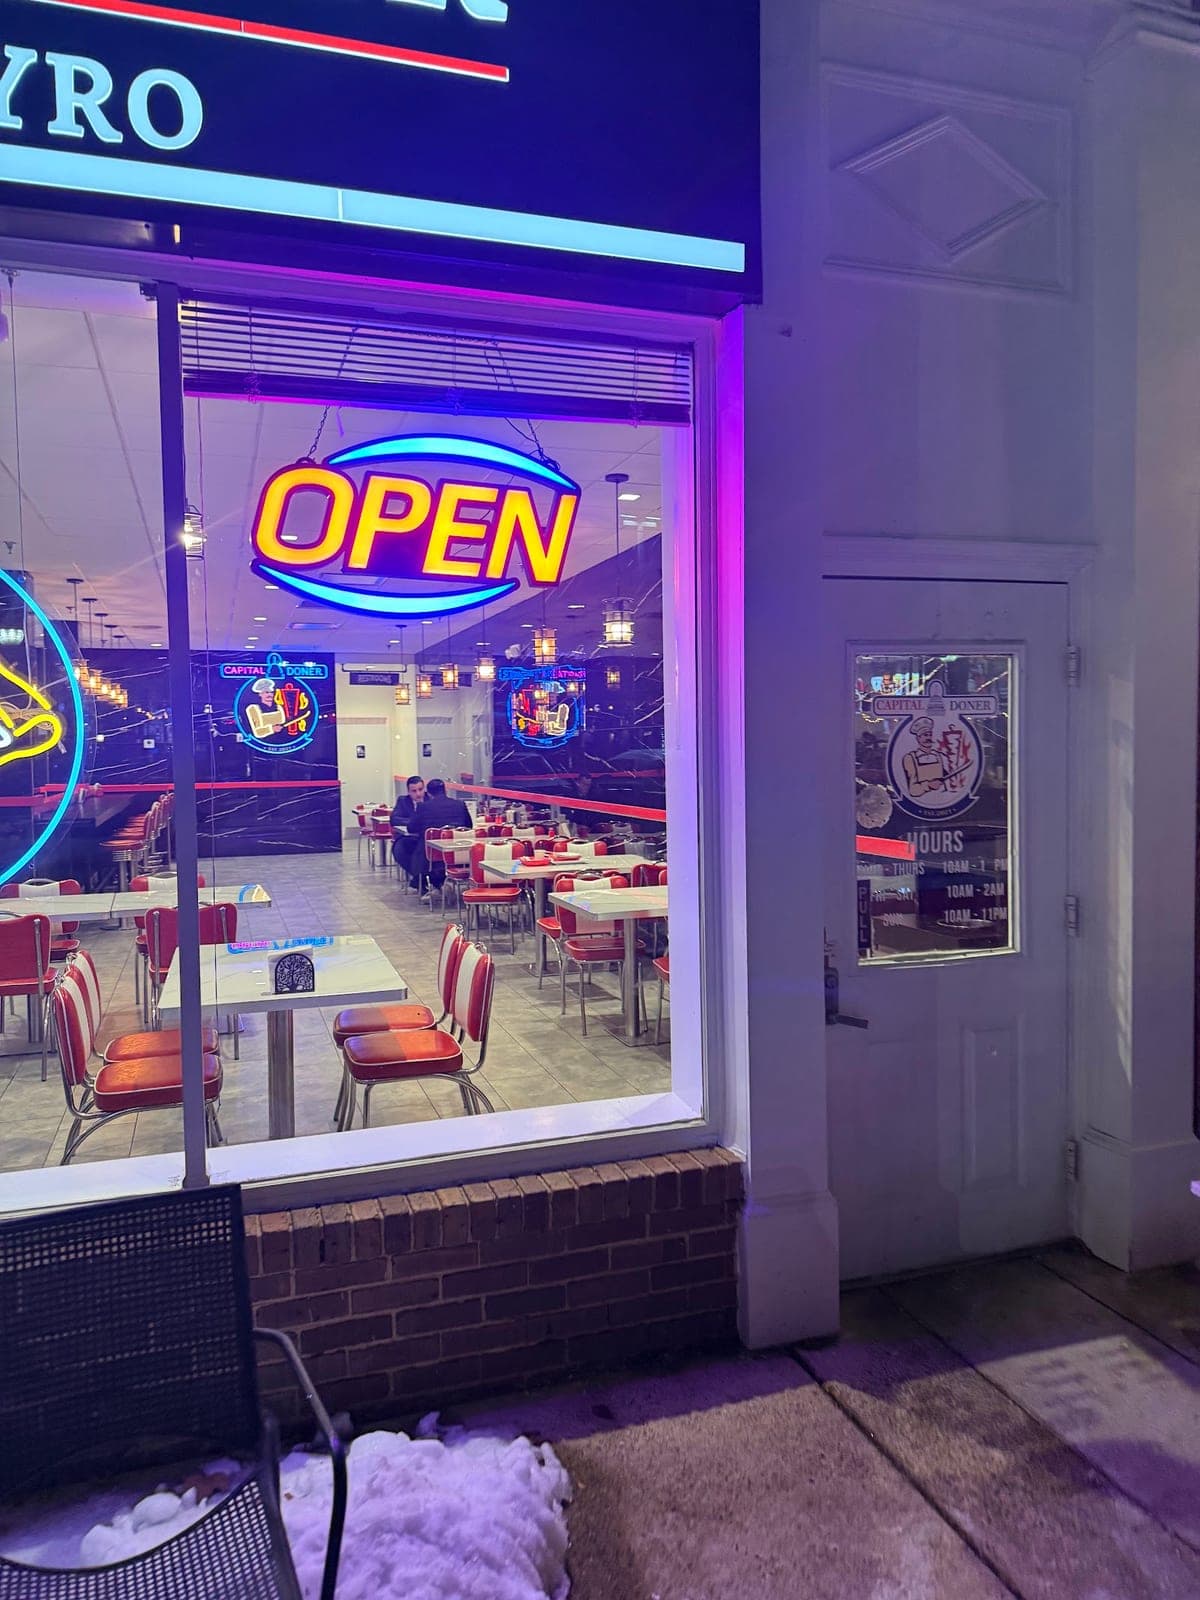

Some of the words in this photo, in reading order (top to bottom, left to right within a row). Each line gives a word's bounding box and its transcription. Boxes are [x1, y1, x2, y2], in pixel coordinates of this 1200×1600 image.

[254, 466, 579, 584] OPEN
[223, 665, 266, 675] CAPITAL
[286, 667, 324, 676] DONER
[876, 700, 926, 711] CAPITAL
[950, 700, 992, 711] DONER
[907, 830, 963, 854] HOURS
[893, 861, 926, 875] THURS
[947, 884, 974, 898] 10AM
[983, 883, 1005, 897] 2AM
[858, 886, 869, 943] PULL
[944, 909, 971, 924] 10AM
